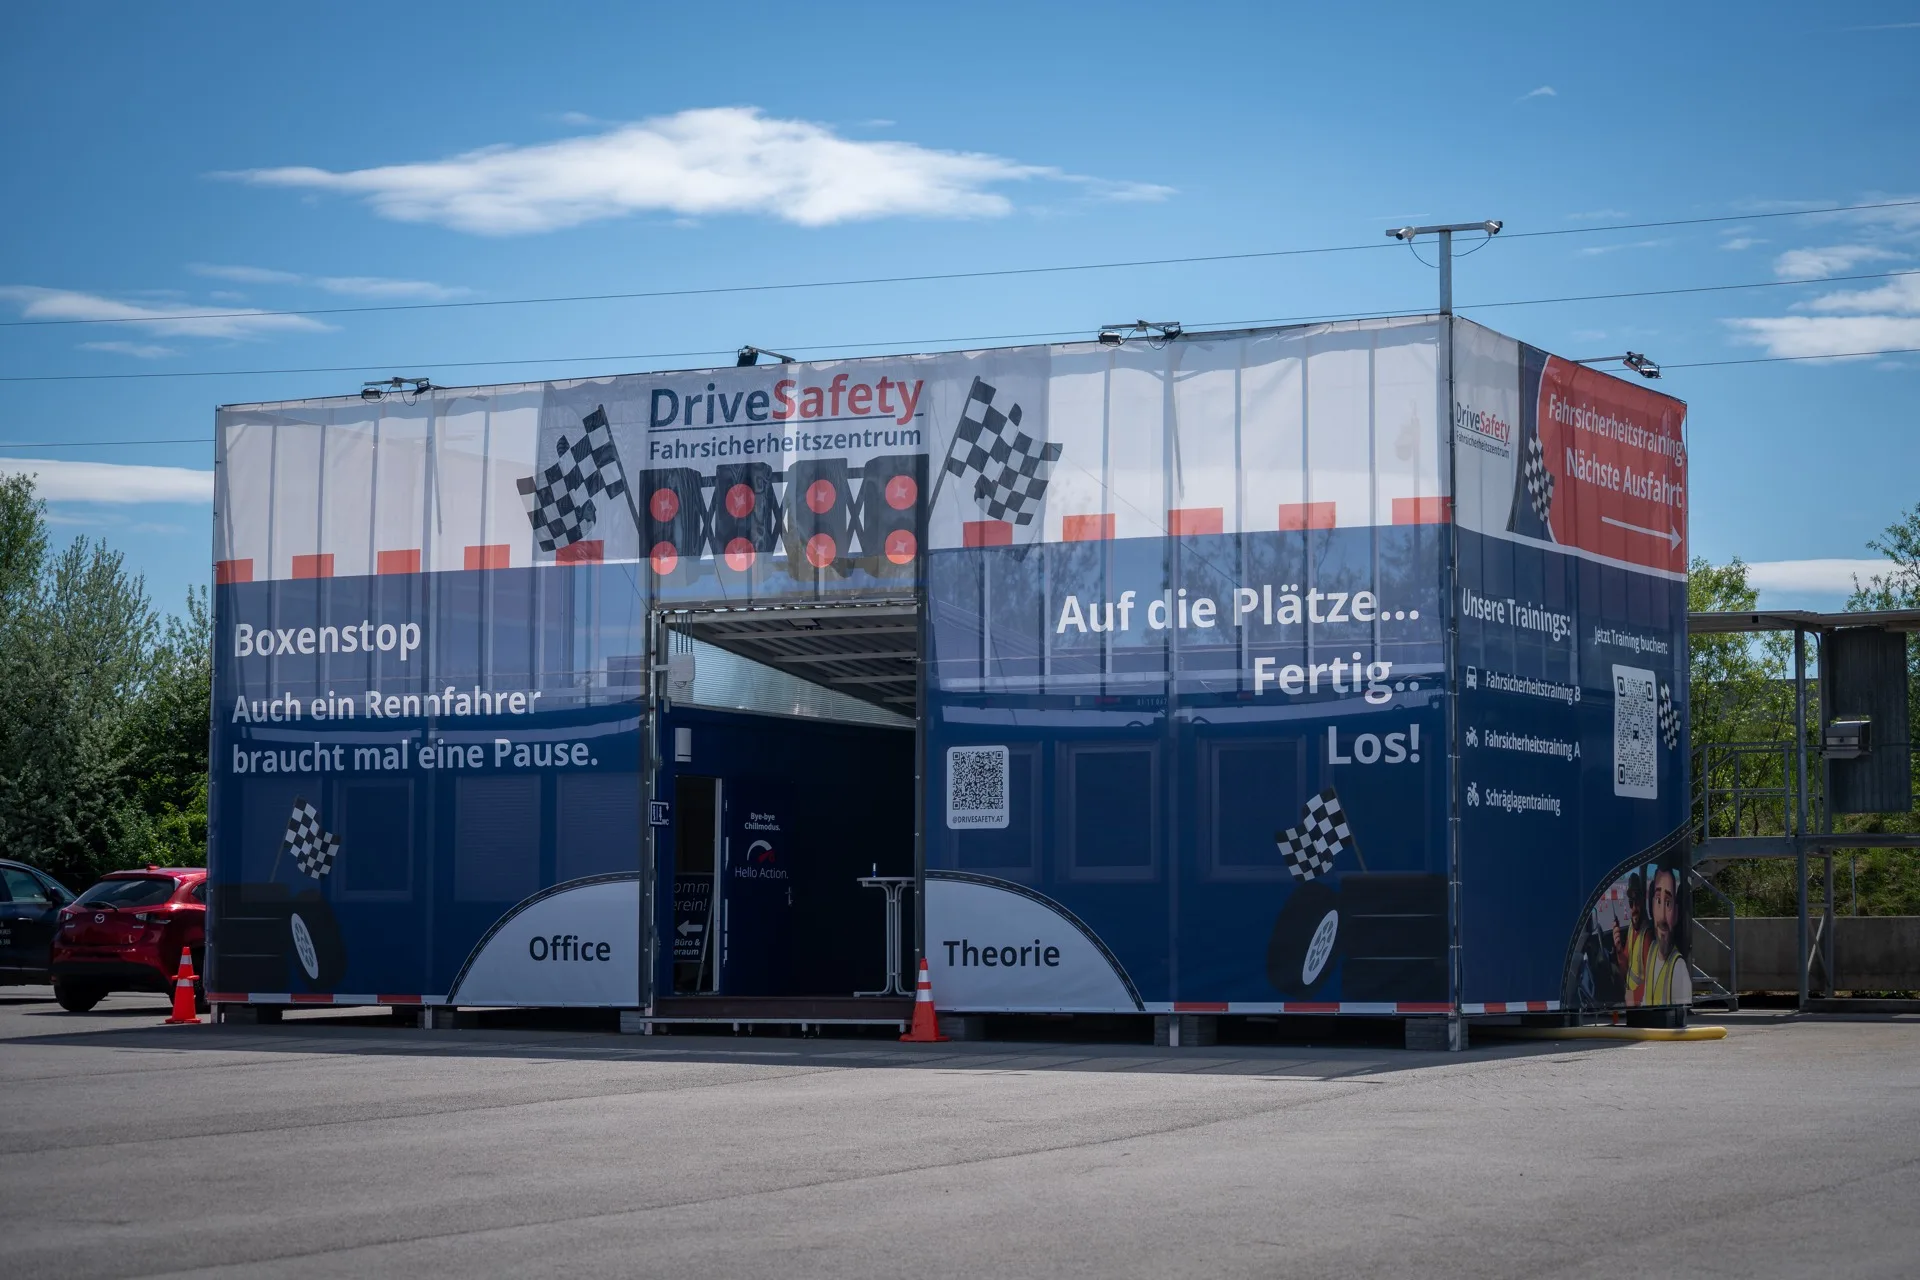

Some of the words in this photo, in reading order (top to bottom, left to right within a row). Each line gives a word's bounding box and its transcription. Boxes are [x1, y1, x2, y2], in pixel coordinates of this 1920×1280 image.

[650, 374, 925, 426] DriveSafety
[1456, 401, 1511, 447] DriveSafety
[1548, 393, 1684, 468] Fahrsicherheitstraining
[649, 428, 922, 460] Fahrsicherheitszentrum
[1456, 430, 1510, 460] Fahrsicherheitszentrum
[1566, 446, 1620, 492] Nächste
[1622, 466, 1683, 509] Ausfahrt
[1056, 590, 1137, 635] Auf
[1147, 588, 1217, 630] die
[1233, 583, 1421, 628] Plätze...
[1462, 587, 1505, 624] Unsere
[1507, 598, 1571, 642] Trainings:
[234, 619, 421, 661] Boxenstop
[1594, 625, 1611, 646] Jetzt
[1612, 629, 1640, 654] Training
[1640, 634, 1668, 655] buchen:
[1254, 651, 1421, 705] Fertig..
[1485, 670, 1574, 706] Fahrsicherheitstraining
[1574, 685, 1581, 702] B
[232, 692, 301, 724] Auch
[310, 690, 355, 721] ein
[365, 685, 541, 719] Rennfahrer
[232, 741, 345, 773] braucht
[354, 739, 409, 771] mal
[418, 738, 485, 770] eine
[494, 738, 598, 768] Pause.
[1327, 723, 1421, 766] Los!
[1484, 729, 1573, 762] Fahrsicherheitstraining
[1573, 741, 1581, 758] A
[750, 812, 776, 823] Bye-bye
[1485, 788, 1561, 817] Schräglagentraining
[744, 822, 781, 831] Chillmodus.
[952, 815, 1004, 824] @DRIVESAFETY.AT
[674, 881, 710, 894] omm
[734, 866, 758, 878] Hello
[758, 867, 789, 880] Action.
[528, 934, 611, 962] Office
[673, 948, 699, 956] eraum
[943, 939, 1061, 968] Theorie
